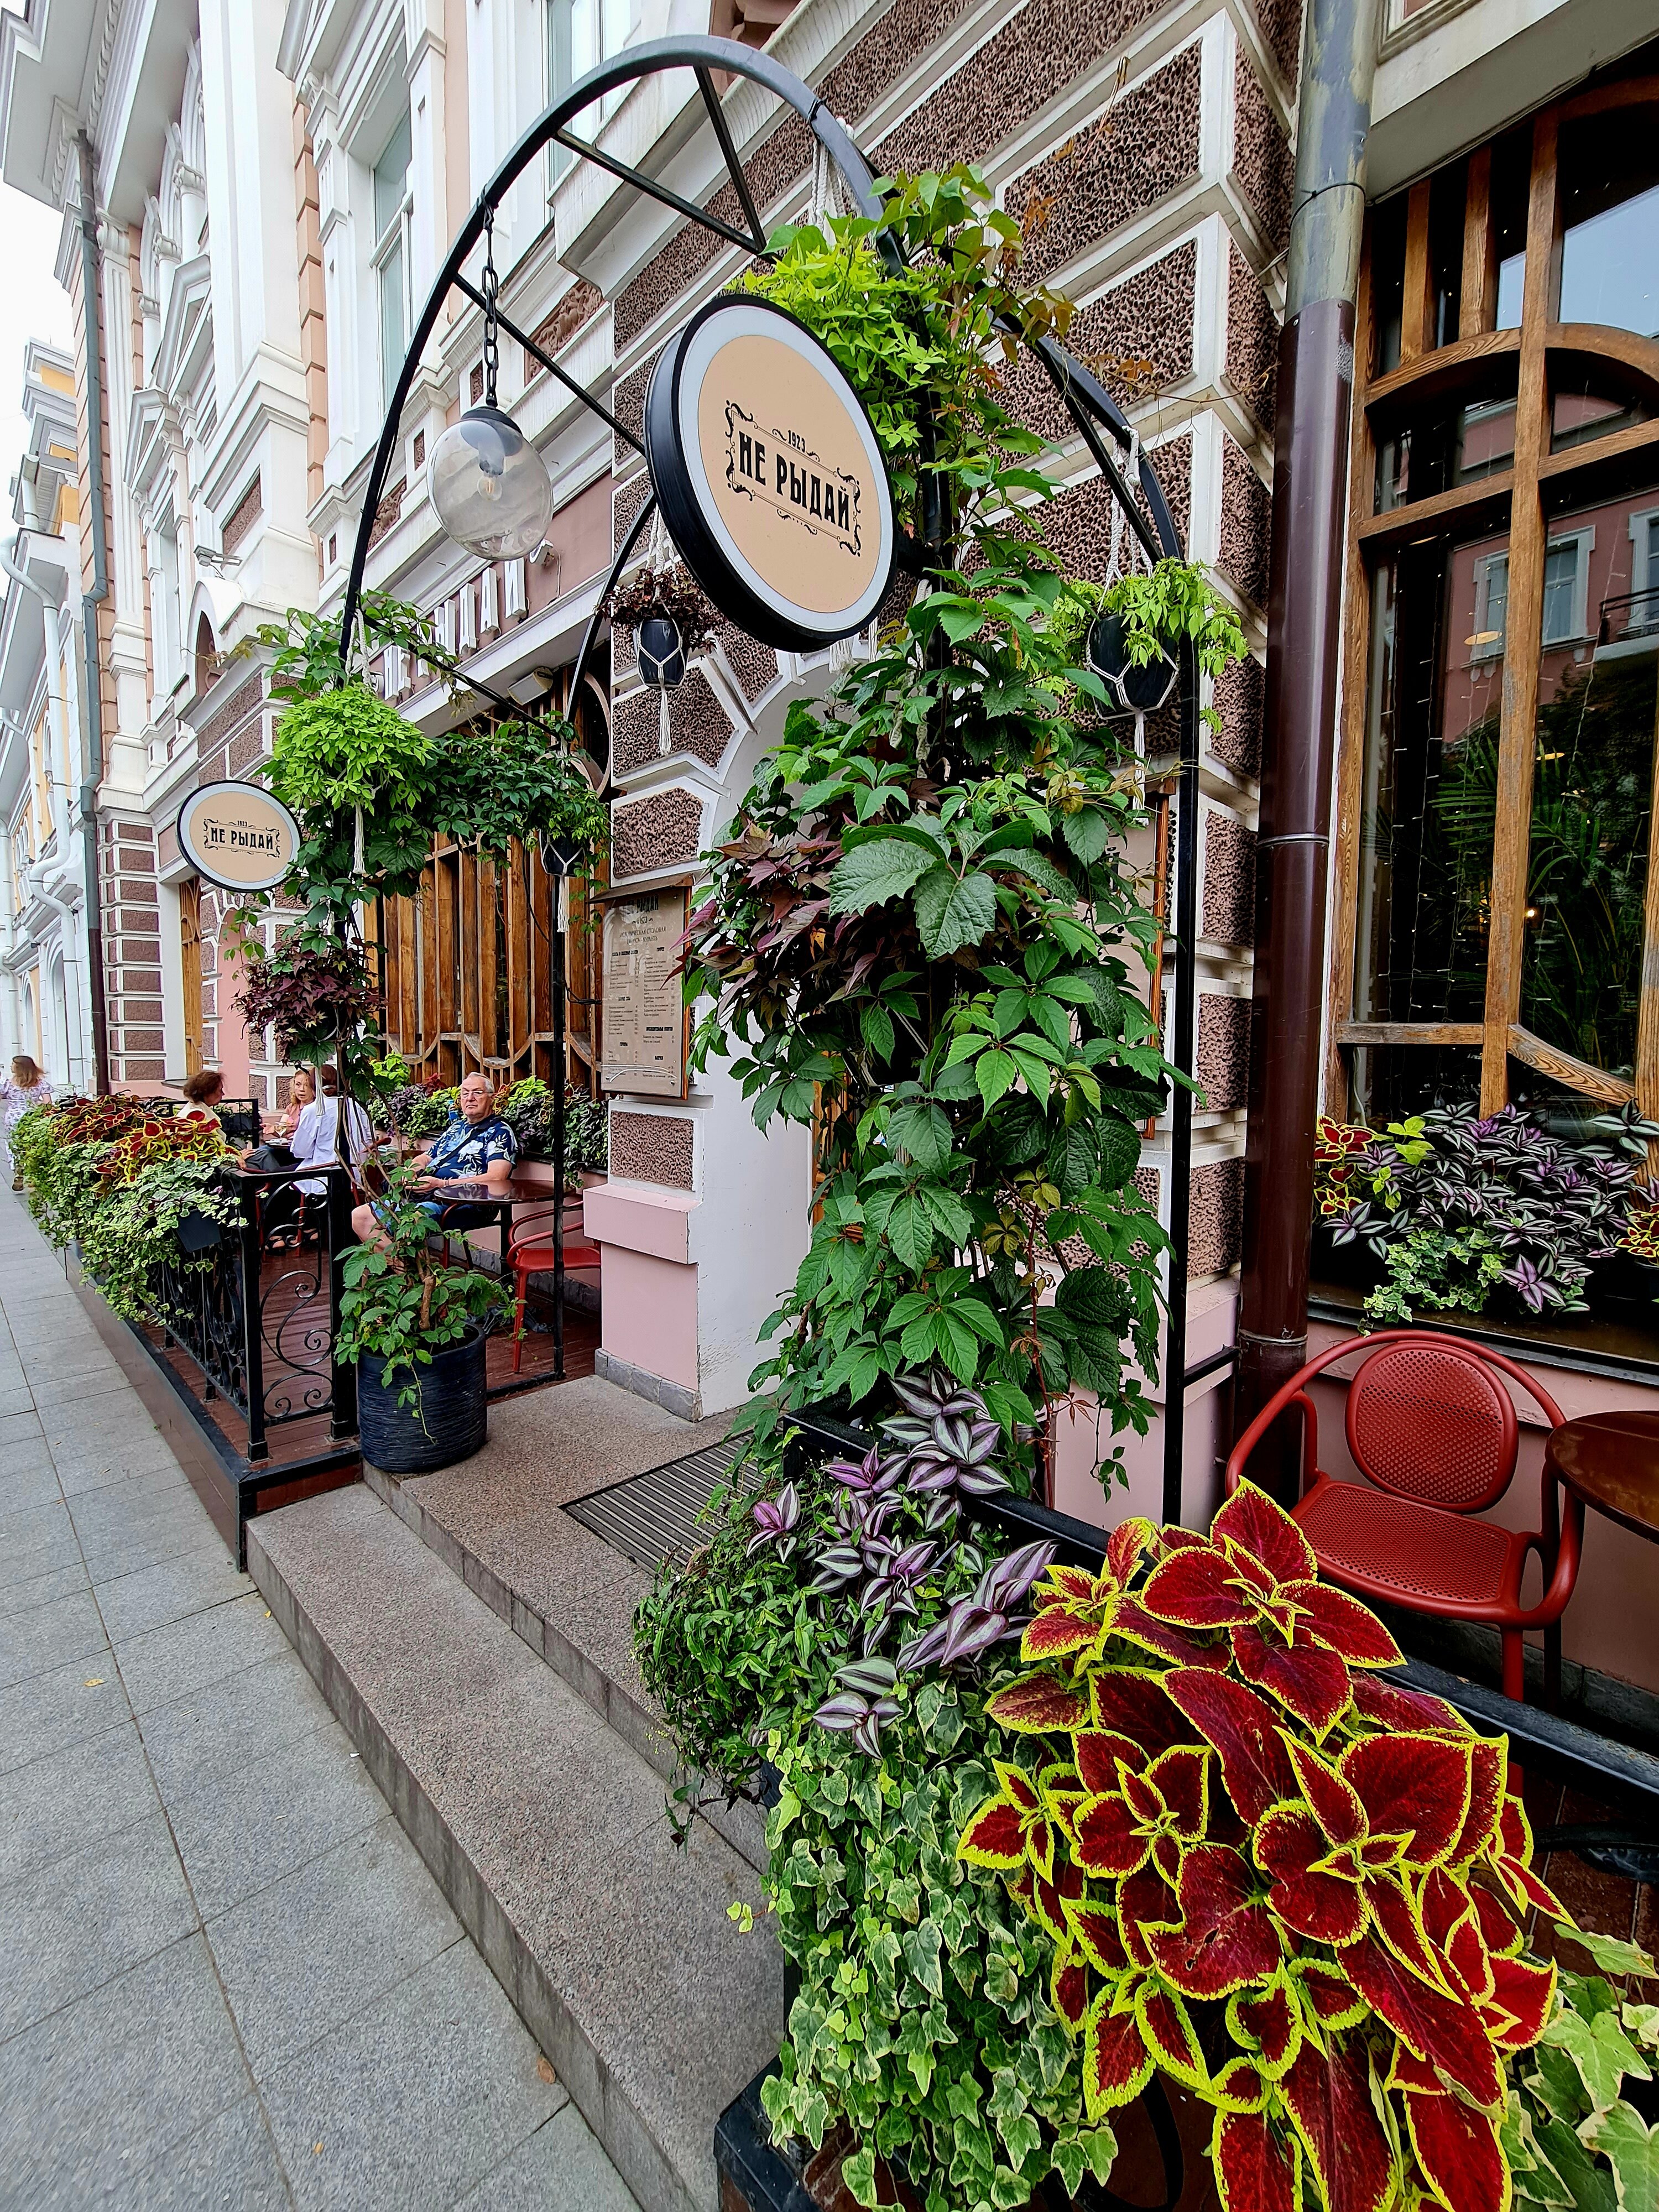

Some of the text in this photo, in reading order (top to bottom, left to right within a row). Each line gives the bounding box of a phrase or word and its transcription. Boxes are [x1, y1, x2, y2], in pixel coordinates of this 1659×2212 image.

[787, 430, 806, 453] 1923
[738, 430, 850, 532] НЕ РЫДАЙ
[211, 827, 273, 849] НЕ РЫДАЙ
